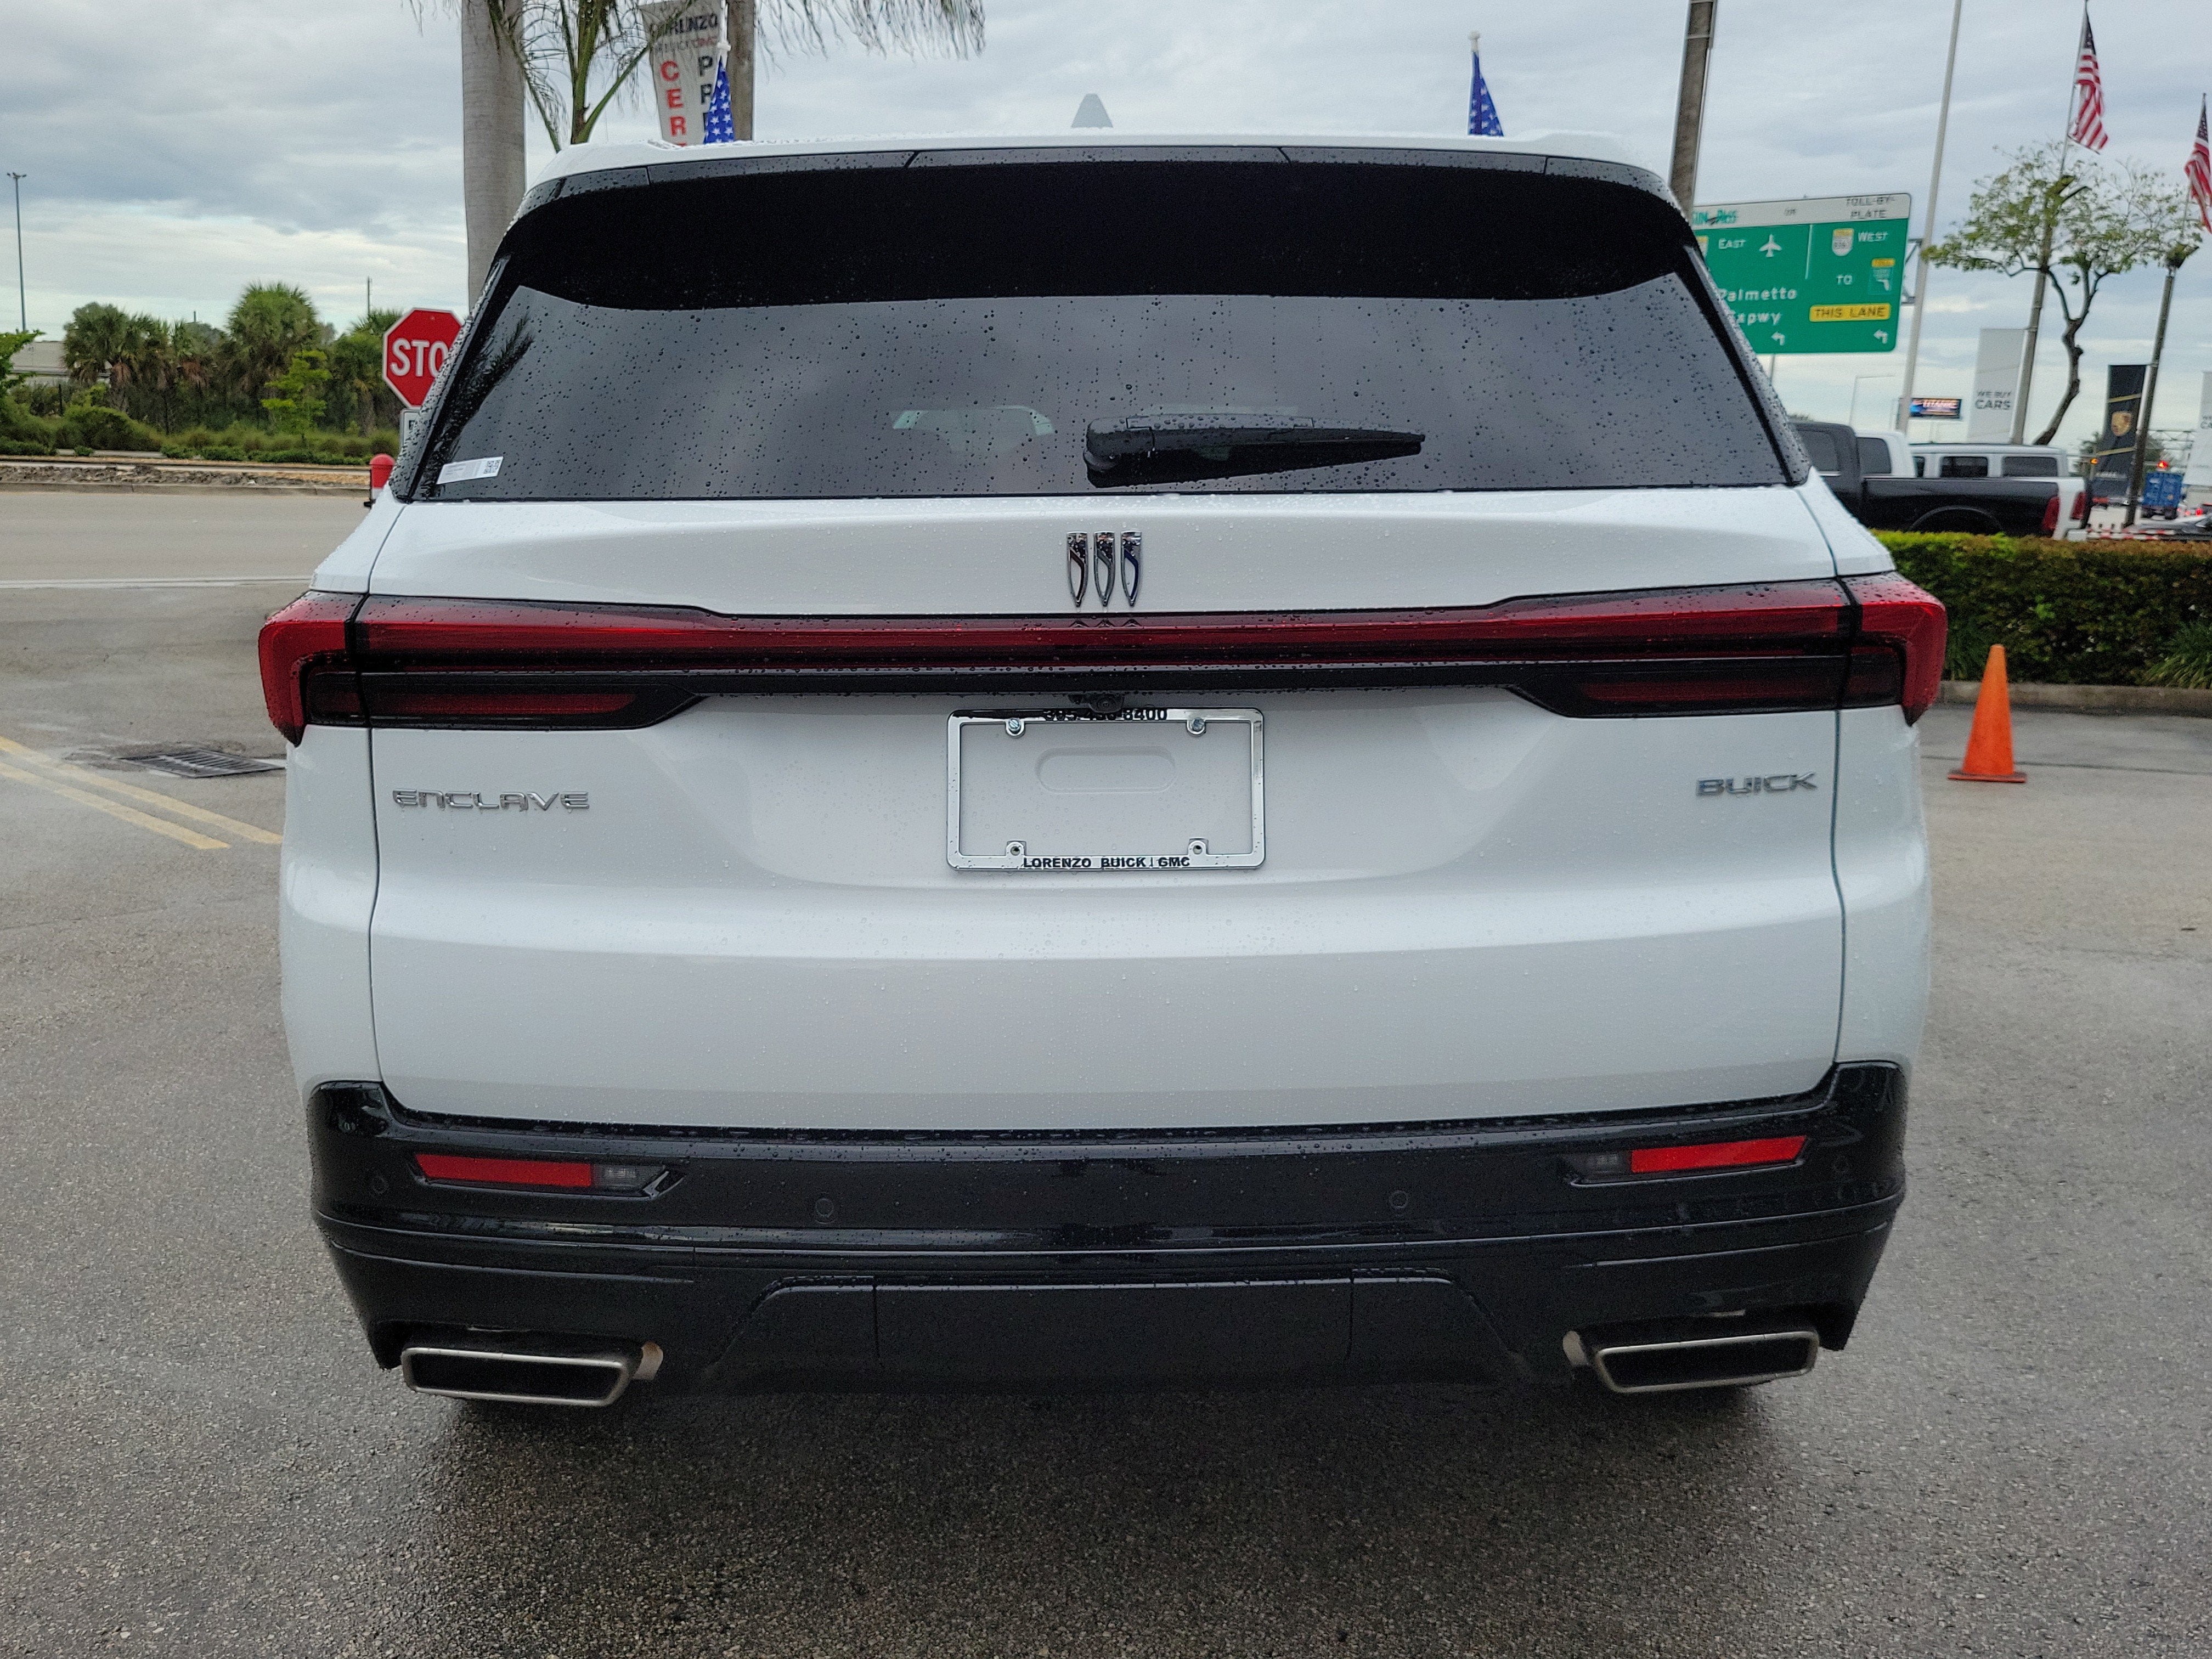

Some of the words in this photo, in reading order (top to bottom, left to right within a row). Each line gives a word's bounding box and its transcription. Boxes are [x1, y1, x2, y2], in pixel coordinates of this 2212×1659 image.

[660, 60, 687, 146] CER
[1836, 275, 1853, 285] TO
[1815, 308, 1843, 318] THIS
[1849, 305, 1886, 318] LANE
[390, 337, 449, 379] STO
[1976, 399, 2011, 410] CARS
[1696, 772, 1816, 797] BUICK
[392, 788, 590, 812] ENCLAVE
[1023, 857, 1091, 868] LORENZO
[1101, 856, 1147, 868] BUICK
[1158, 856, 1190, 867] GMC
